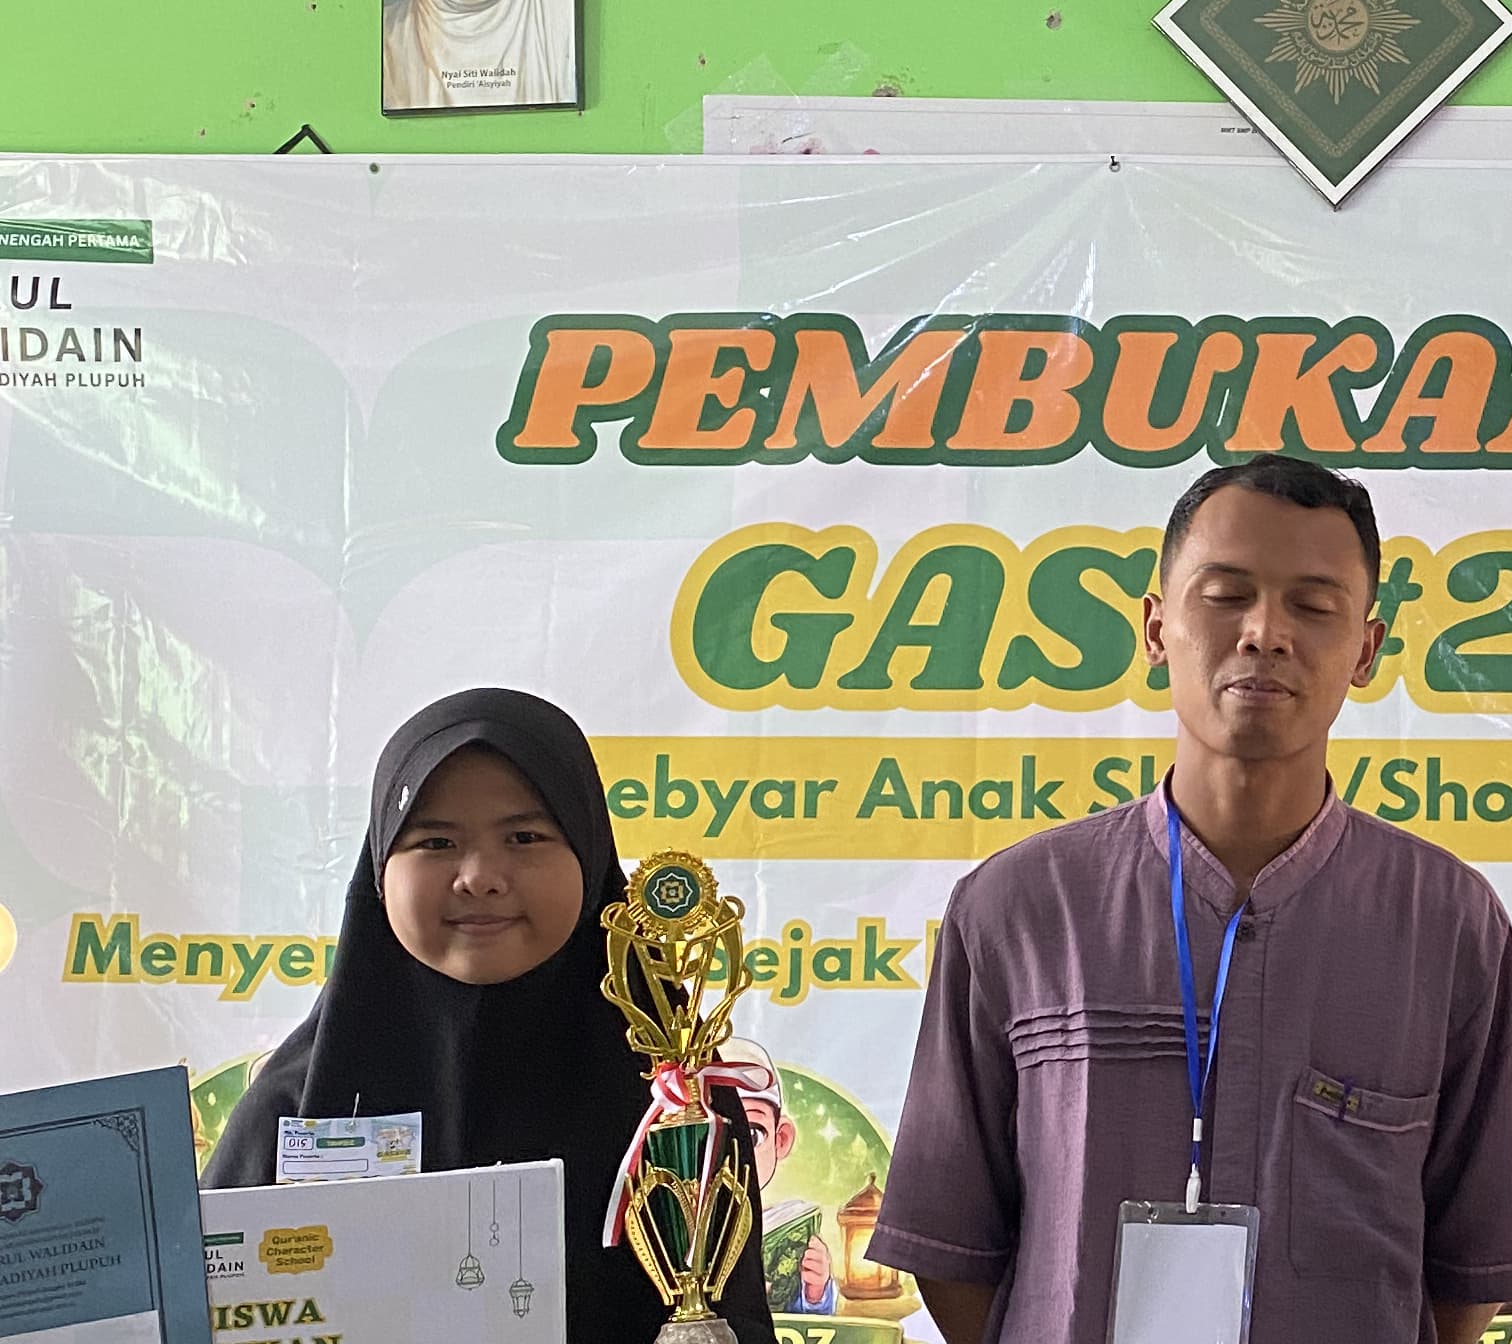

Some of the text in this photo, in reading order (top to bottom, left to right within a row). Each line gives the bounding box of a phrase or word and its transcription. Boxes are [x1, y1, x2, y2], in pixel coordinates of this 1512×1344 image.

[68, 234, 140, 248] PERTAMA
[66, 373, 145, 388] PLUPUH
[856, 754, 1067, 820] Anak
[266, 1244, 325, 1257] Character
